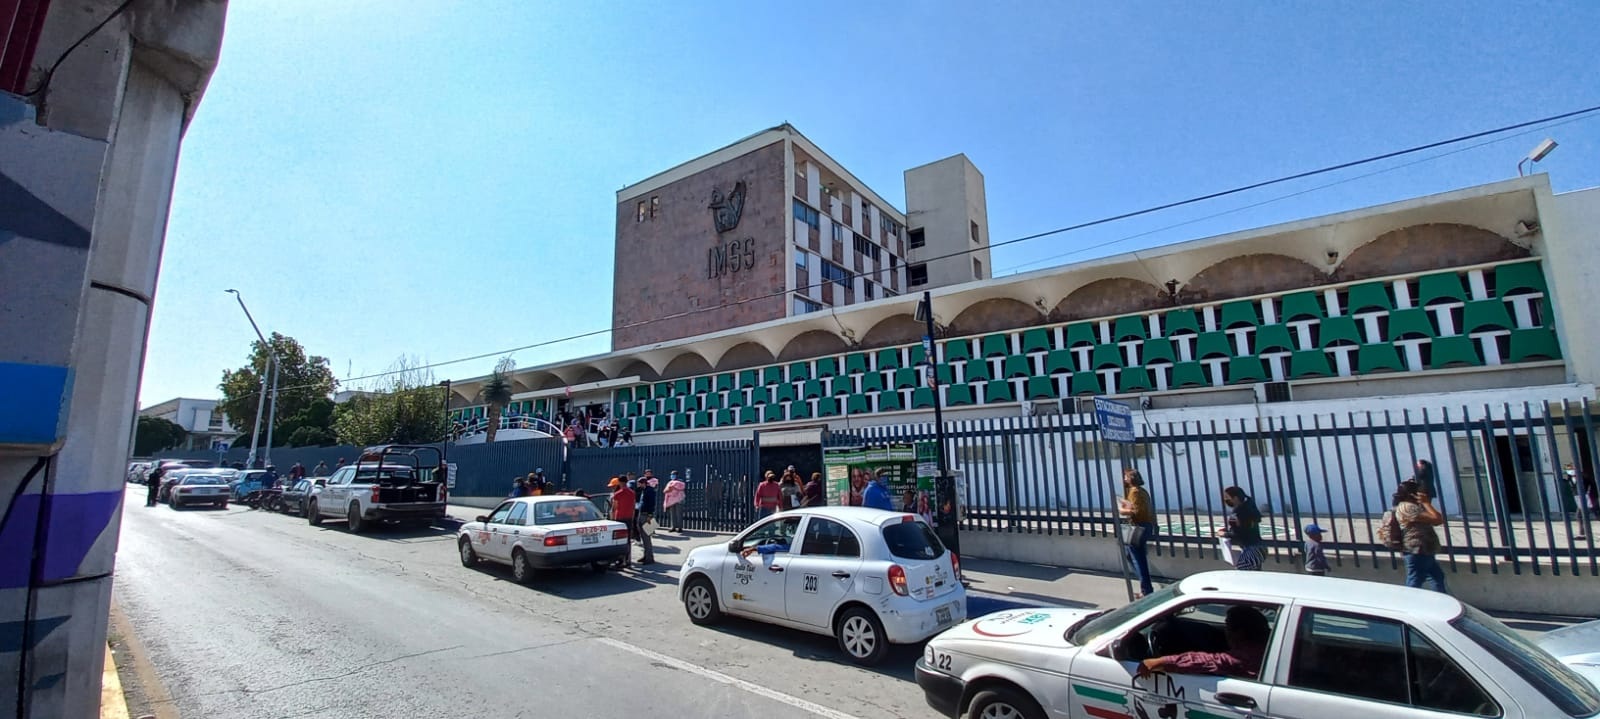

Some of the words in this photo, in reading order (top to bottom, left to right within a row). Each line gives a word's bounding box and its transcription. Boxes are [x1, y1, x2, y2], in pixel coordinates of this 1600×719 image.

[707, 237, 755, 279] IMSS
[805, 575, 818, 592] 203
[938, 653, 952, 671] 22
